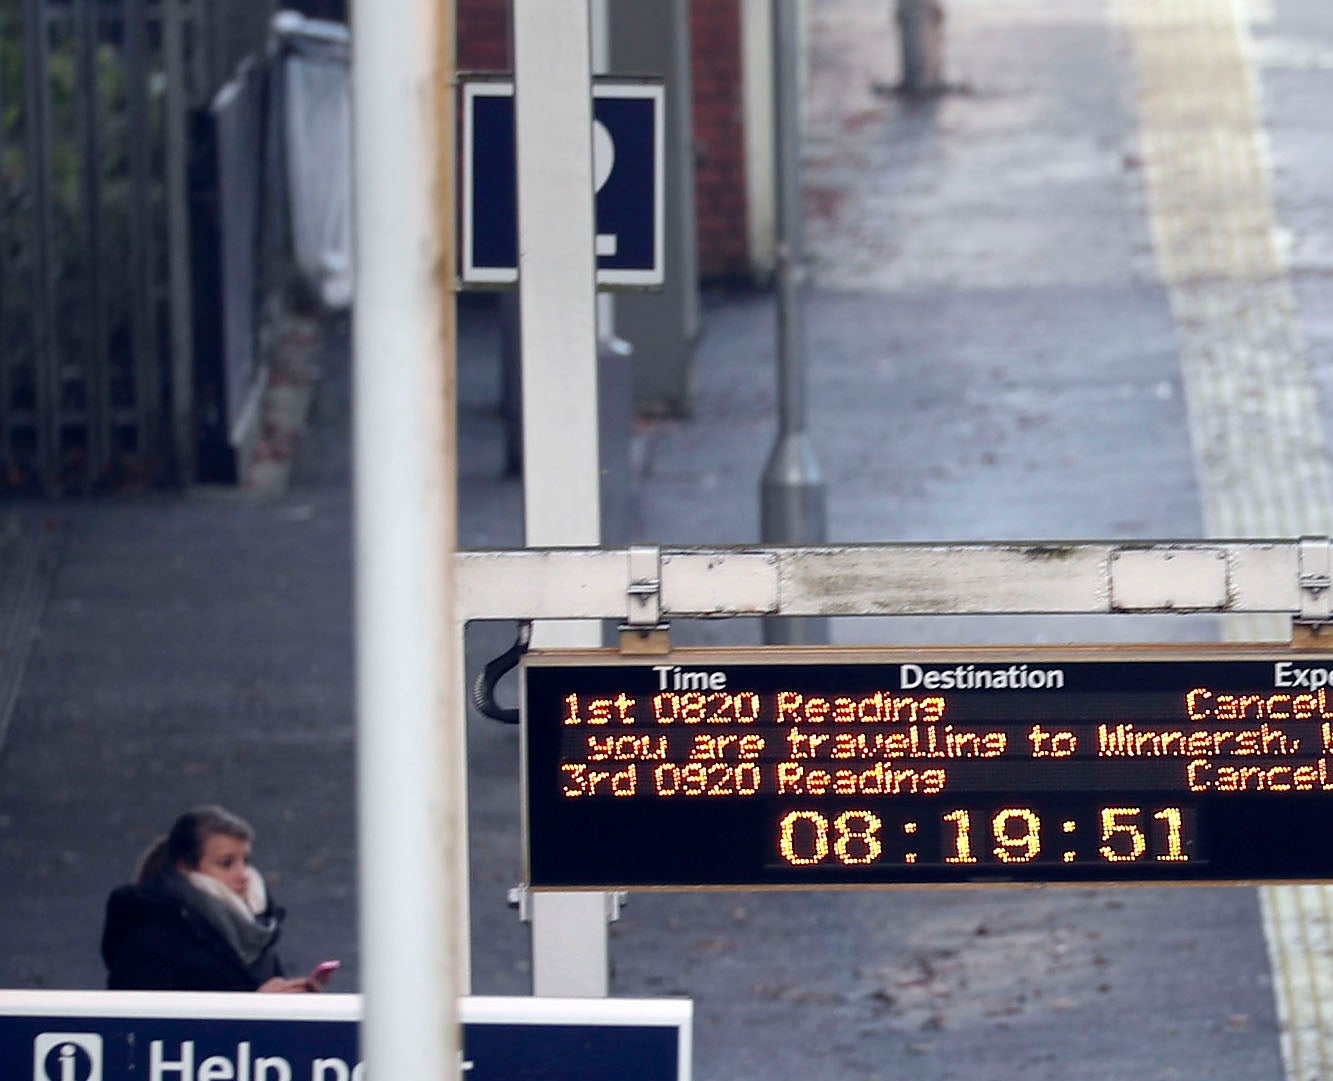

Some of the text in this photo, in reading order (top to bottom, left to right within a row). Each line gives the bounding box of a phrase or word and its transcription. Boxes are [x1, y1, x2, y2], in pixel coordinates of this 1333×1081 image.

[652, 665, 727, 691] Time
[899, 664, 1065, 690] Destination
[564, 692, 636, 725] 1st
[652, 691, 761, 725] 0820
[775, 690, 947, 724] Reading
[586, 734, 670, 761] you
[689, 733, 766, 760] are
[786, 725, 1008, 760] travelling
[1027, 724, 1078, 759] to
[1096, 722, 1301, 757] Winnersh,
[561, 762, 638, 797] 3rd
[653, 761, 762, 797] 0920
[776, 761, 948, 796] Reading
[778, 807, 1190, 865] 08:19:51
